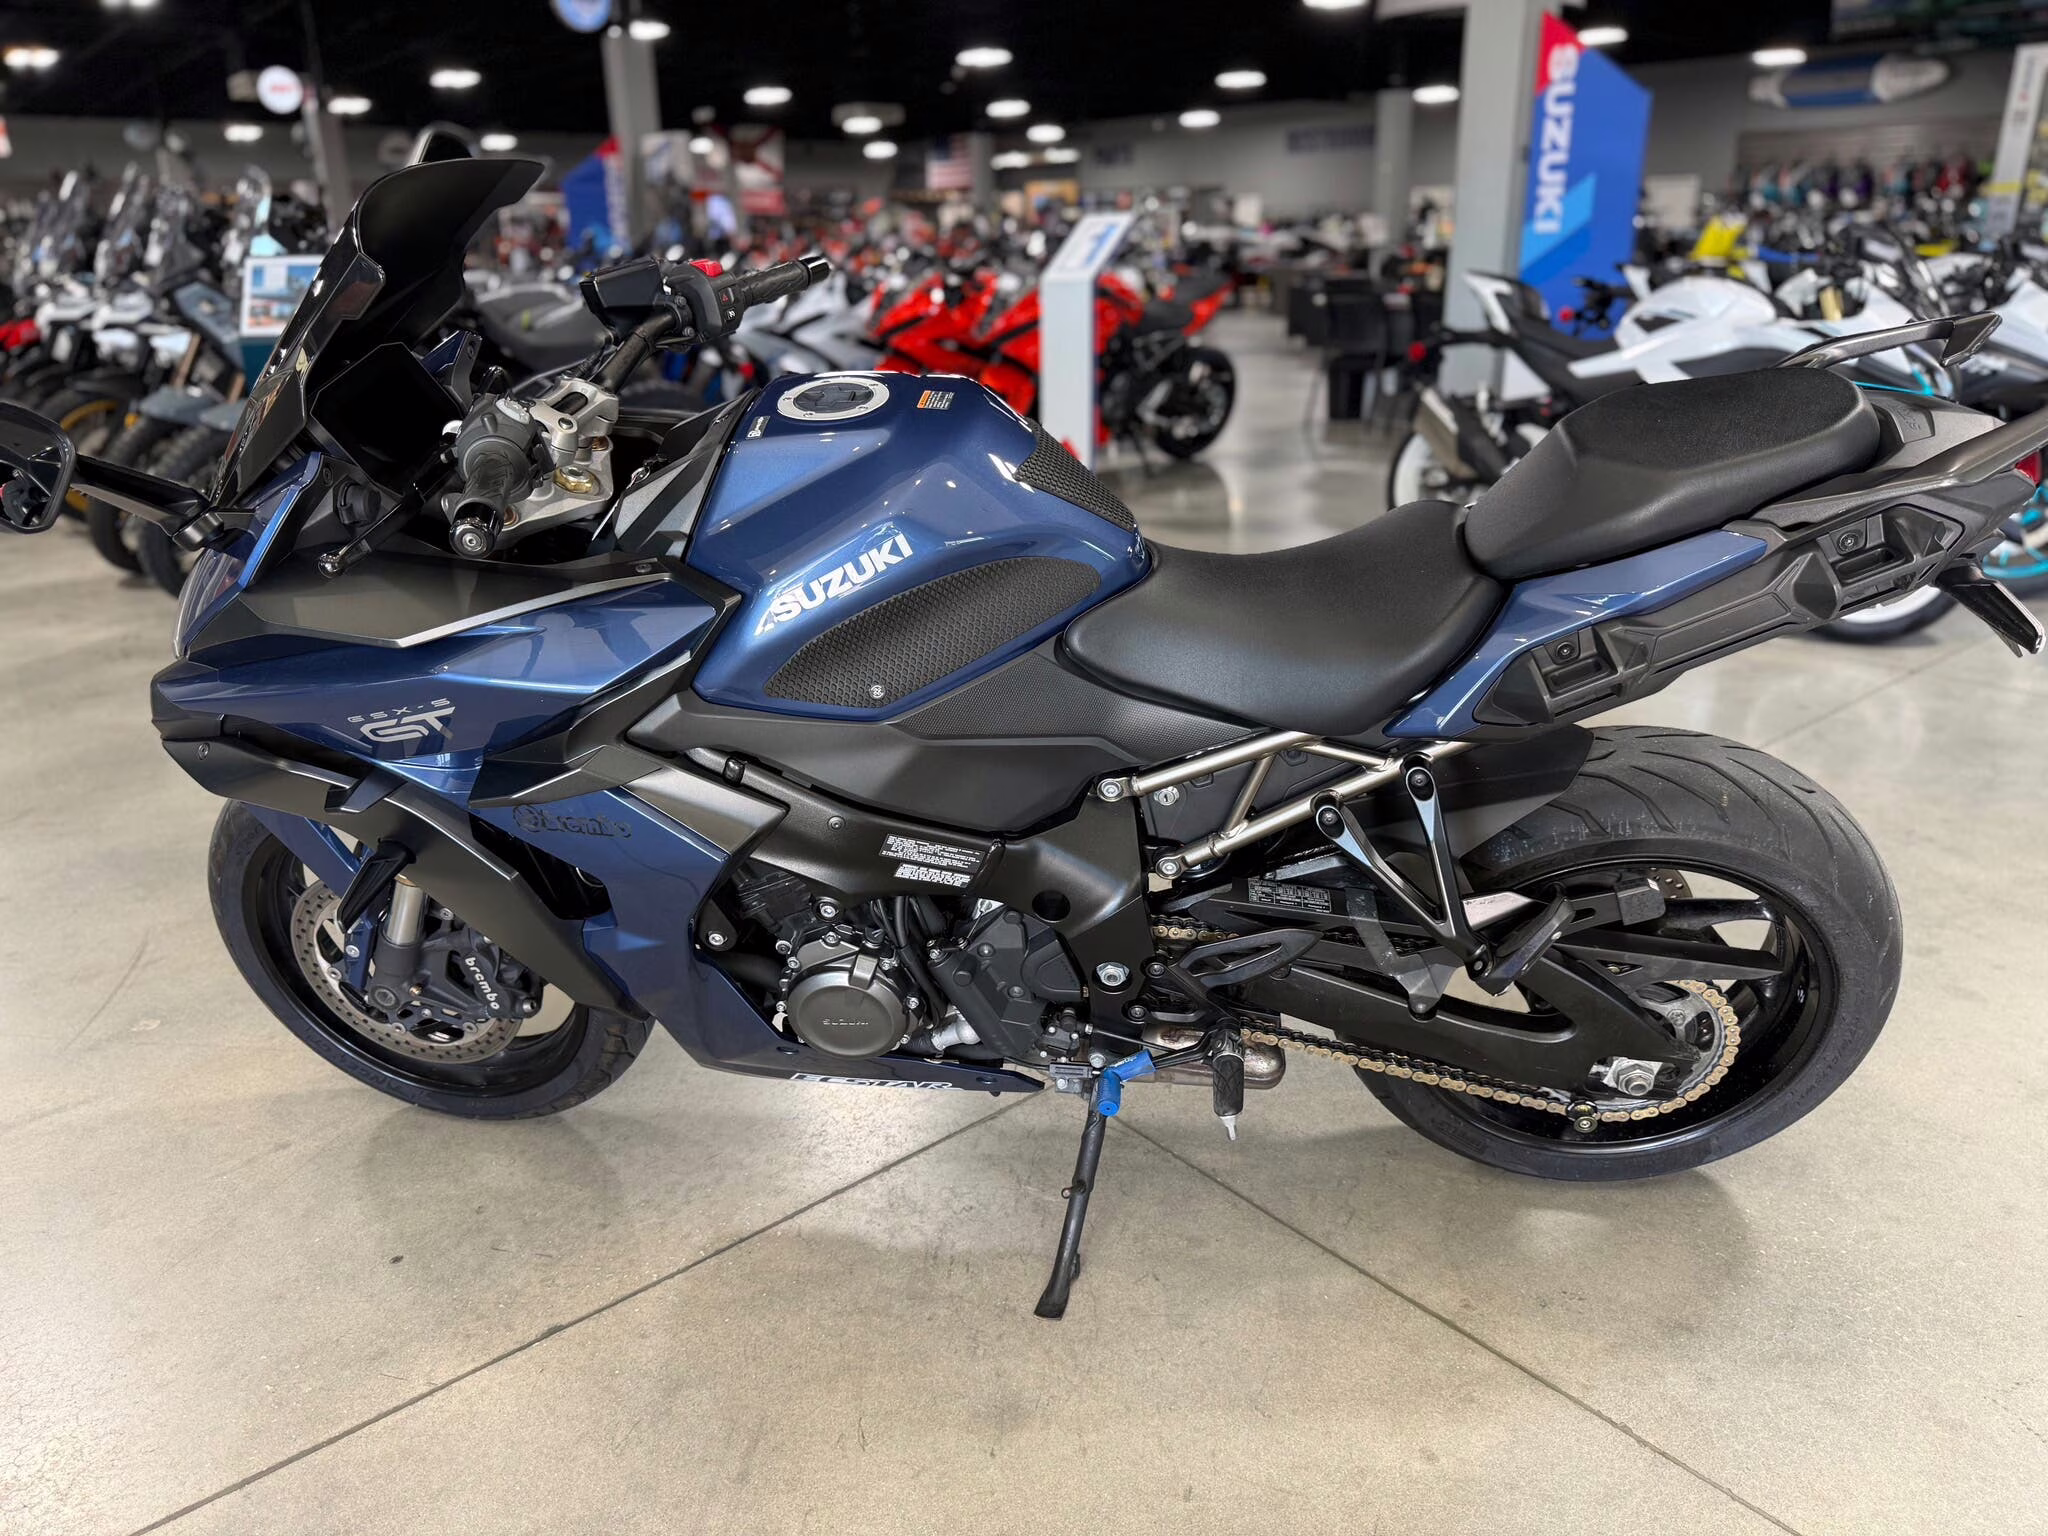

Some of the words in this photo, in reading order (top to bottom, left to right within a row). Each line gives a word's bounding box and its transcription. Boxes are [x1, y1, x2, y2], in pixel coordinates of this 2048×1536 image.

[1533, 43, 1580, 234] SUZUKI
[772, 533, 914, 623] SUZUKI
[346, 698, 451, 723] GSX-S
[359, 706, 456, 743] GT
[464, 956, 500, 1010] brembo
